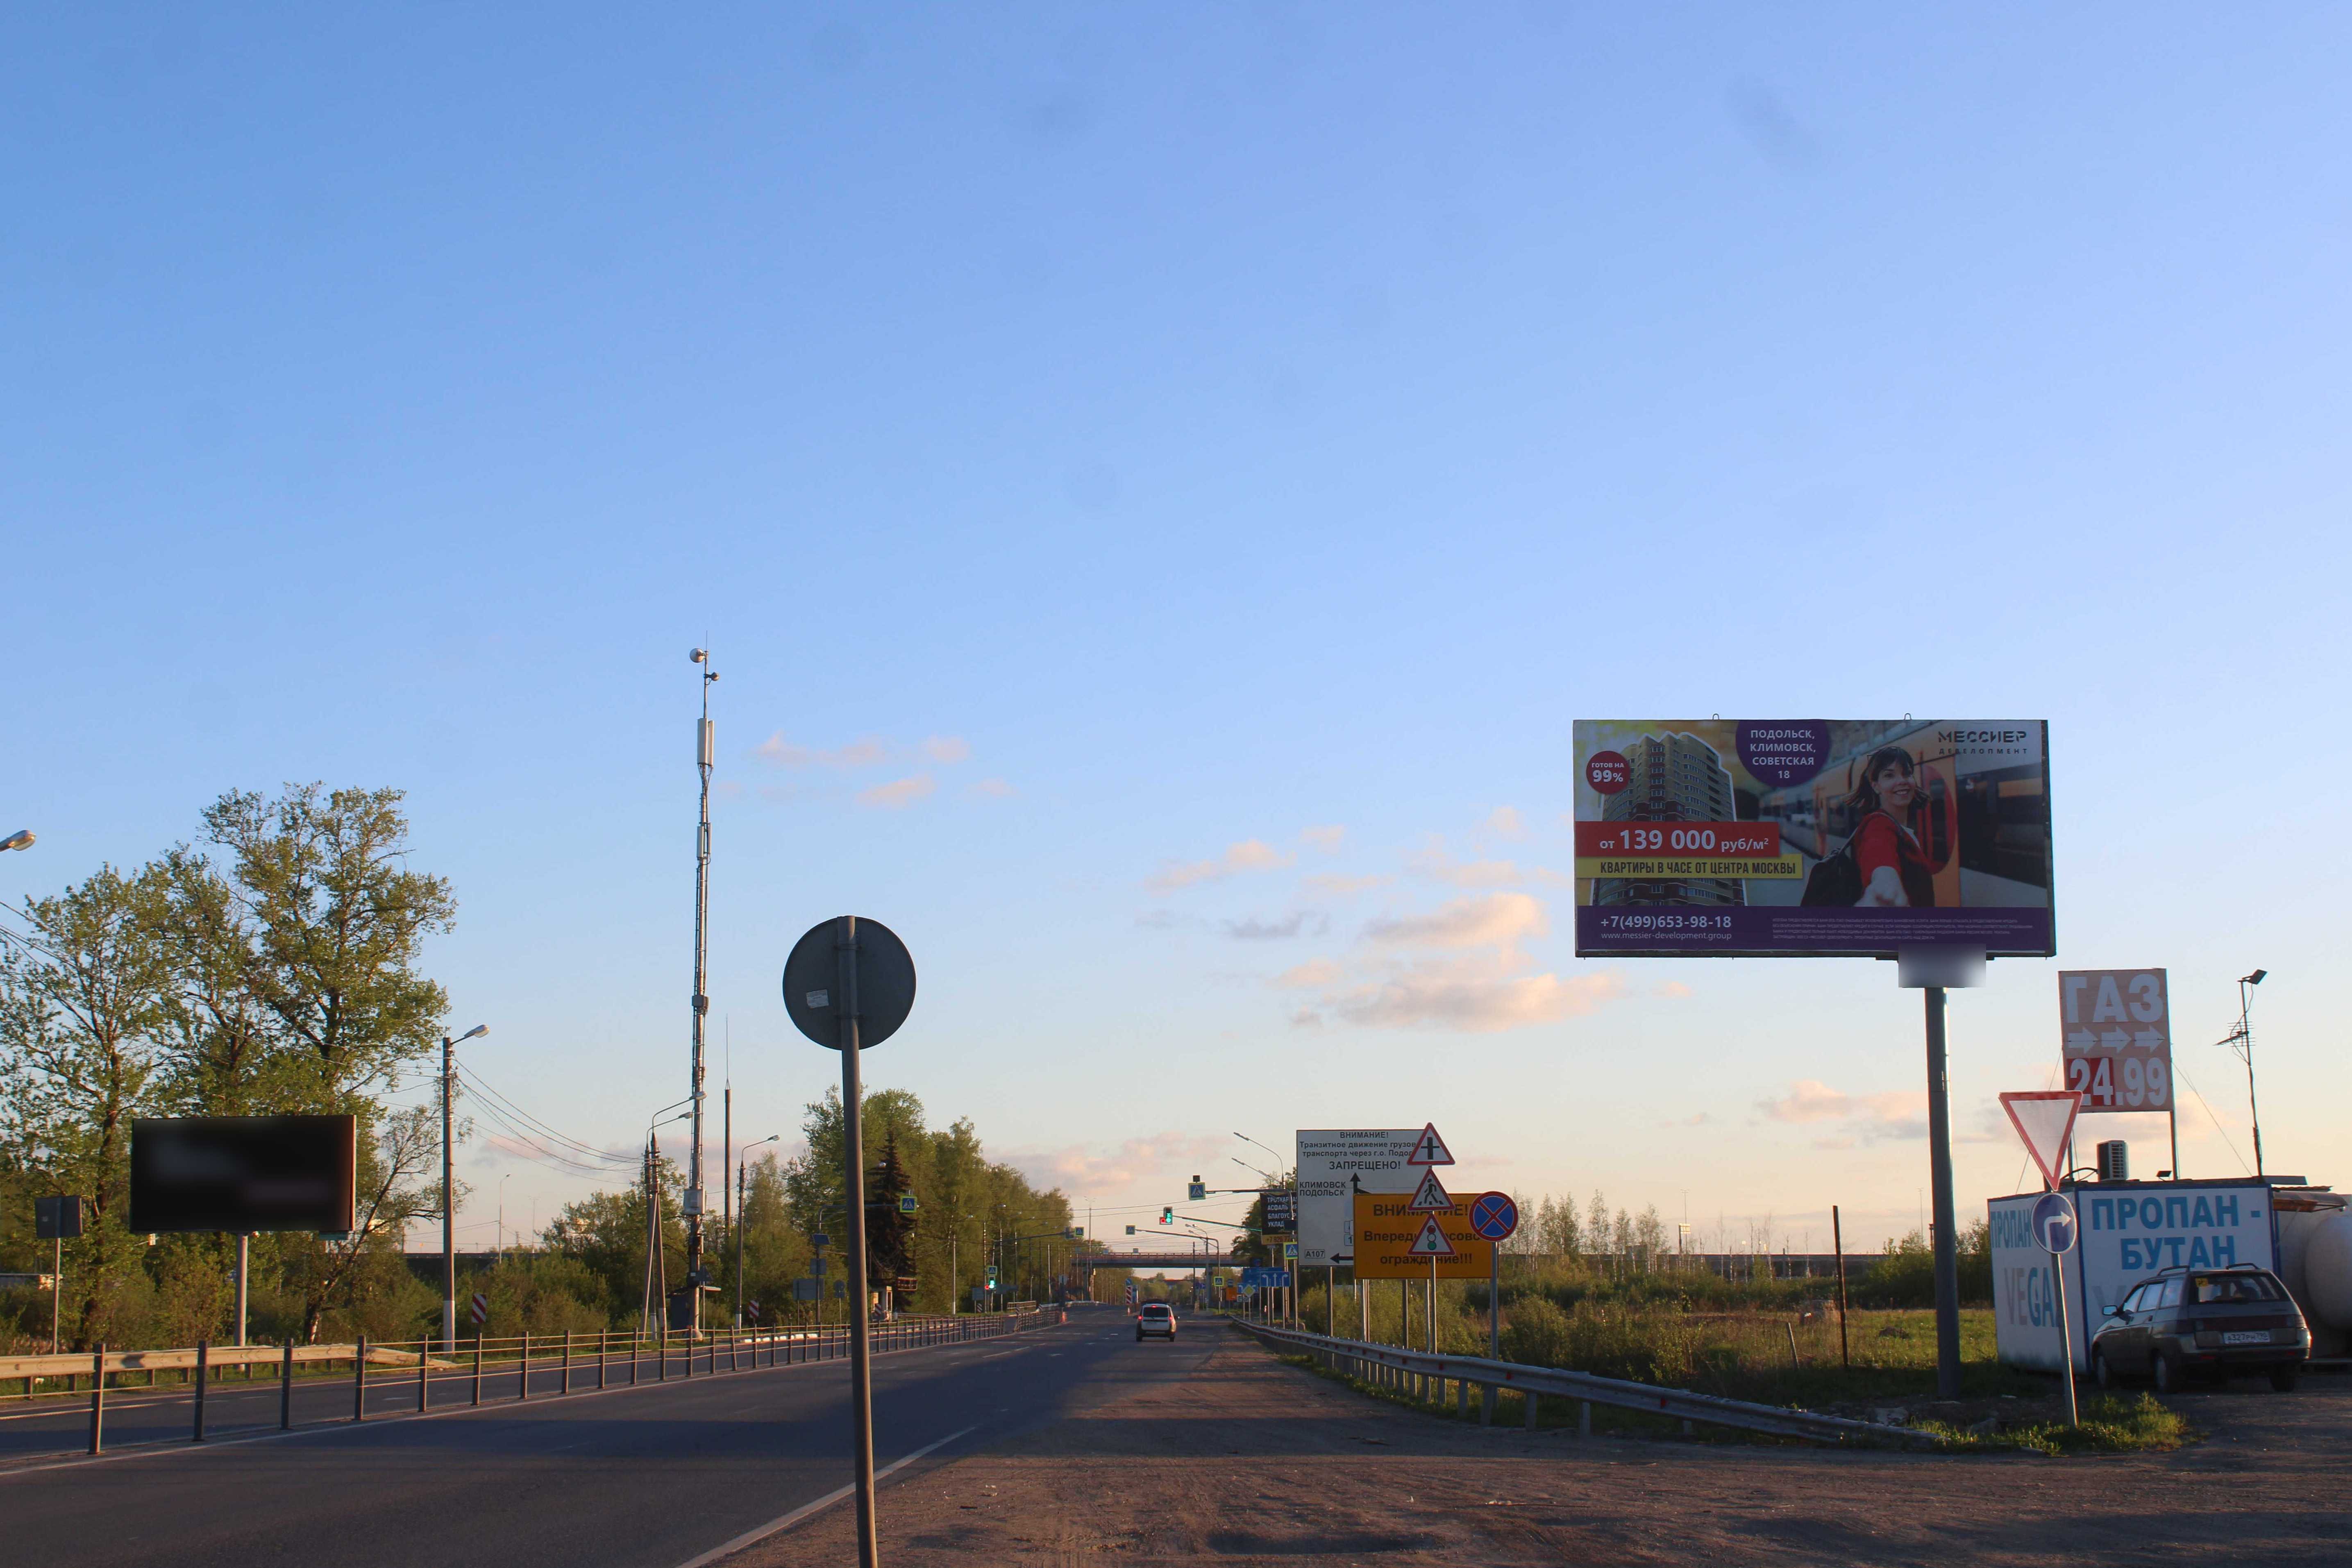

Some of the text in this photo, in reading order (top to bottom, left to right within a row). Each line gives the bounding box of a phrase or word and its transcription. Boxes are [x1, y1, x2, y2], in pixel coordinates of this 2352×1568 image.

[1750, 730, 1815, 740] ПОДОЛЬСК,
[1750, 744, 1816, 753] КЛИМОВСК,
[1752, 756, 1814, 765] СОВЕТСКАЯ
[1592, 770, 1623, 782] 99%
[1778, 770, 1790, 778] 18
[1600, 841, 1615, 849] от
[1620, 829, 1662, 850] 139
[1671, 830, 1716, 849] 000
[1600, 862, 1796, 875] КВАРТИРЫ В ЧАСЕ ОТ ЦЕНТРА МОСКВЫ
[1601, 916, 1732, 930] +7(499)653-98-18
[1601, 932, 1732, 940] www.messier-development.group
[2065, 973, 2164, 1023] ГАЗ
[2070, 1057, 2168, 1107] 24.99
[1329, 1161, 1401, 1171] ЗАПРЕЩЕНО!
[2091, 1195, 2238, 1230] ПРОПАН
[1990, 1209, 2032, 1249] ПРОПАН
[2120, 1235, 2236, 1270] БУТАН
[2004, 1267, 2061, 1327] VEGA
